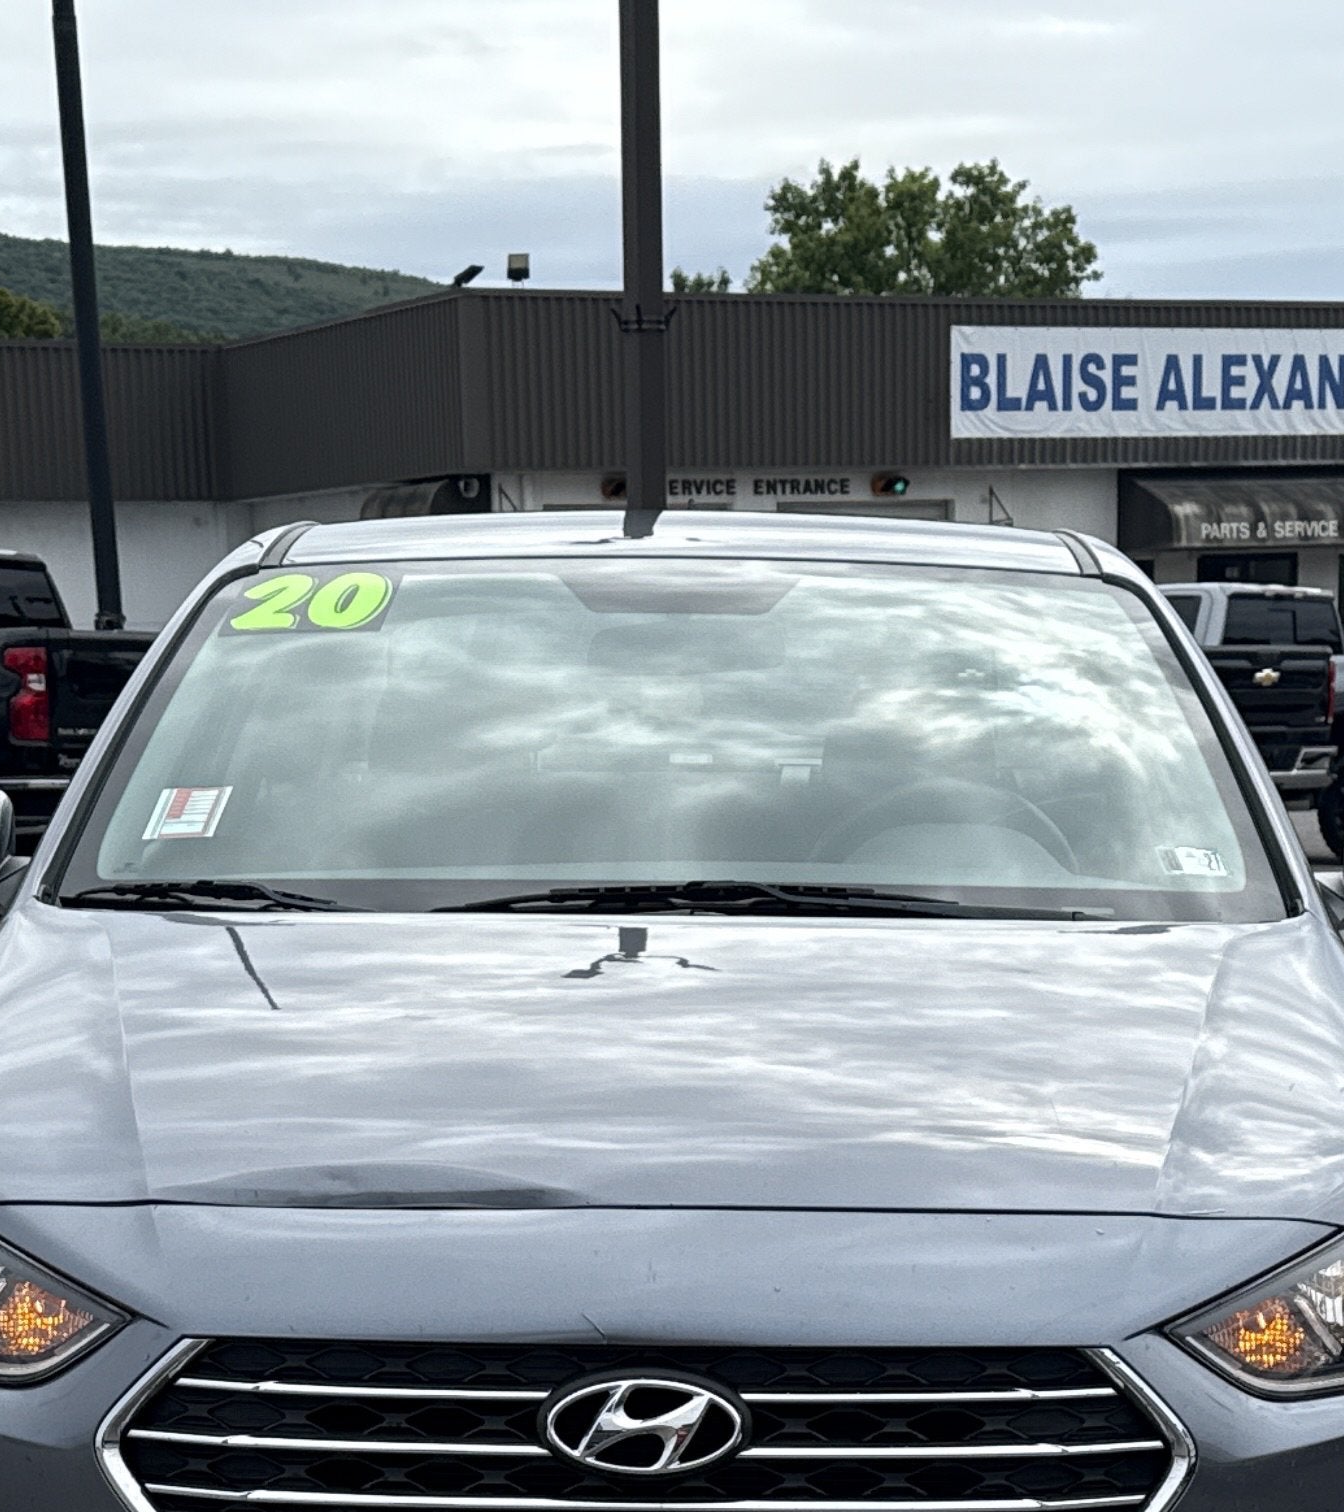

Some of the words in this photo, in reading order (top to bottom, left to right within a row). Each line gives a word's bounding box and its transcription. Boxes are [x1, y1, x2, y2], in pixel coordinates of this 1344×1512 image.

[959, 352, 1139, 413] BLAISE
[668, 479, 737, 496] ERVICE
[753, 477, 851, 495] ENTRANCE
[1200, 522, 1250, 539] PARTS
[1256, 522, 1268, 538] &
[1273, 520, 1338, 537] SERVICE
[230, 572, 393, 631] 20
